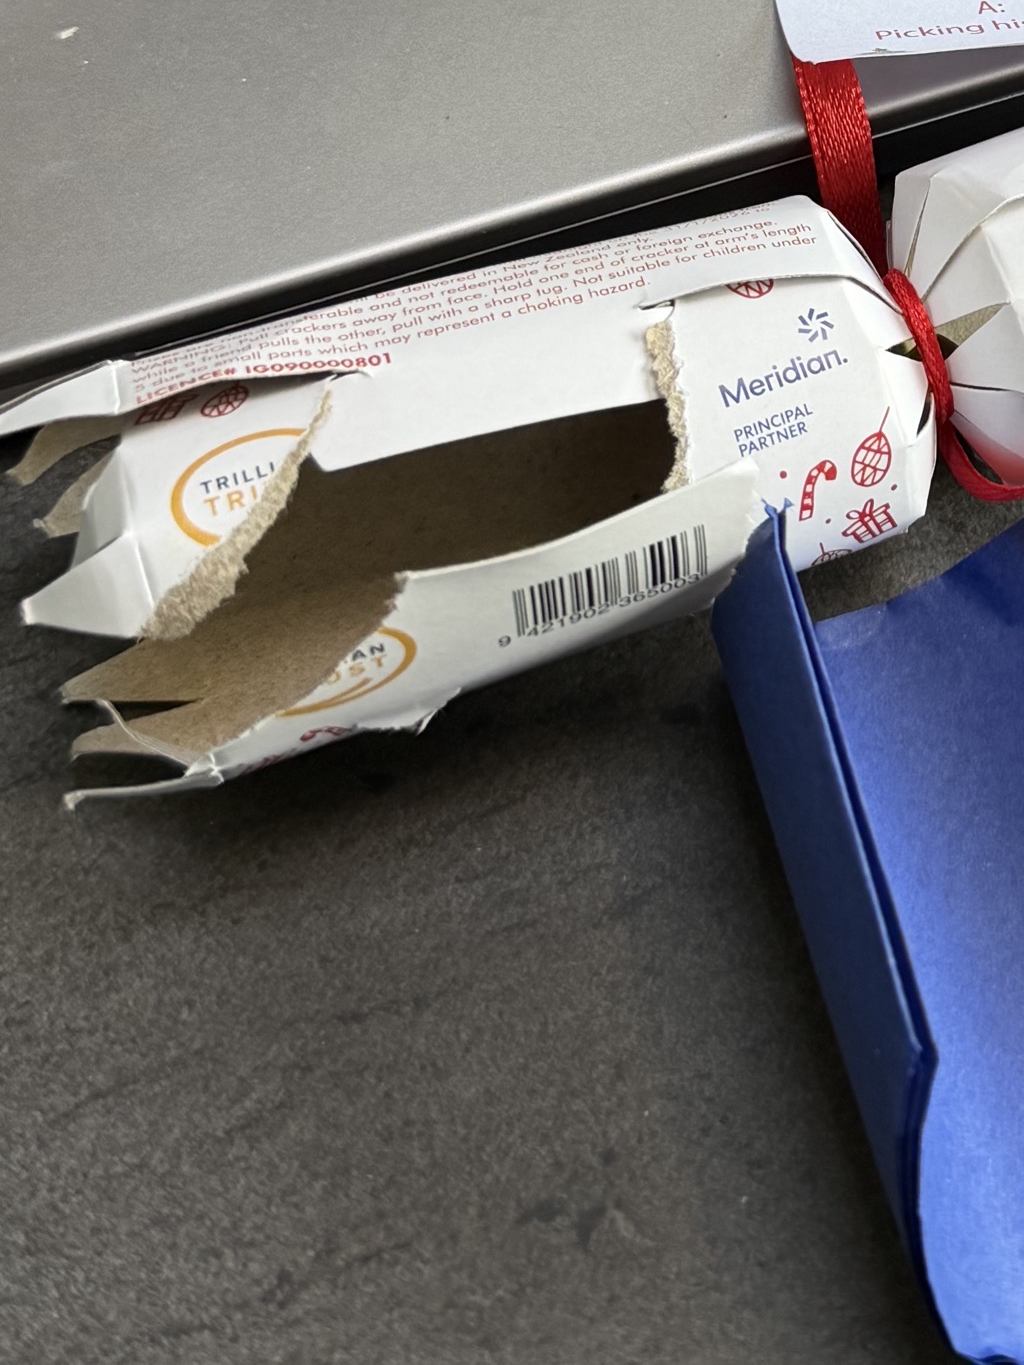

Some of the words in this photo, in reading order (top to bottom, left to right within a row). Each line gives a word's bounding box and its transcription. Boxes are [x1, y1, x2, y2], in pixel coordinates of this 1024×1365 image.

[874, 21, 985, 42] Picking
[977, 0, 1006, 16] A:
[275, 322, 347, 337] crackers
[353, 312, 397, 327] away
[402, 302, 442, 316] from
[447, 293, 488, 306] face.
[494, 278, 533, 295] Hold
[538, 271, 570, 284] one
[575, 261, 605, 276] end
[610, 255, 628, 267] of
[631, 245, 690, 262] cracker
[695, 240, 710, 250] at
[715, 232, 759, 246] arm's
[763, 223, 812, 241] length
[369, 298, 402, 312] and
[408, 291, 434, 304] not
[440, 268, 539, 296] redeemable
[544, 261, 566, 272] for
[572, 253, 609, 265] cash
[614, 247, 630, 256] or
[636, 236, 693, 252] foreign
[698, 219, 778, 240] exchange.
[402, 273, 476, 294] delivered
[483, 269, 497, 277] in
[503, 259, 540, 272] New
[546, 243, 611, 263] Zealand
[617, 236, 654, 248] only.
[201, 344, 251, 363] friend
[259, 336, 299, 351] pulls
[305, 334, 333, 345] the
[338, 326, 386, 342] other,
[392, 316, 423, 334] pull
[429, 307, 463, 323] with
[468, 305, 480, 313] a
[485, 292, 532, 310] sharp
[536, 284, 568, 298] tug.
[573, 274, 603, 287] Not
[608, 258, 671, 279] suitable
[675, 253, 698, 265] for
[703, 241, 766, 259] children
[771, 235, 817, 249] under
[152, 371, 185, 387] due
[192, 365, 209, 373] to
[214, 350, 261, 367] small
[268, 346, 312, 361] parts
[318, 341, 368, 355] which
[374, 334, 411, 349] may
[416, 314, 496, 339] represent
[501, 310, 512, 319] a
[518, 292, 584, 316] choking
[588, 275, 651, 299] hazard.
[136, 367, 236, 404] LICENCE#
[245, 352, 392, 375] IG090000801
[733, 403, 814, 442] PRINCIPAL
[738, 421, 808, 457] PARTNER
[618, 573, 701, 608] 365003
